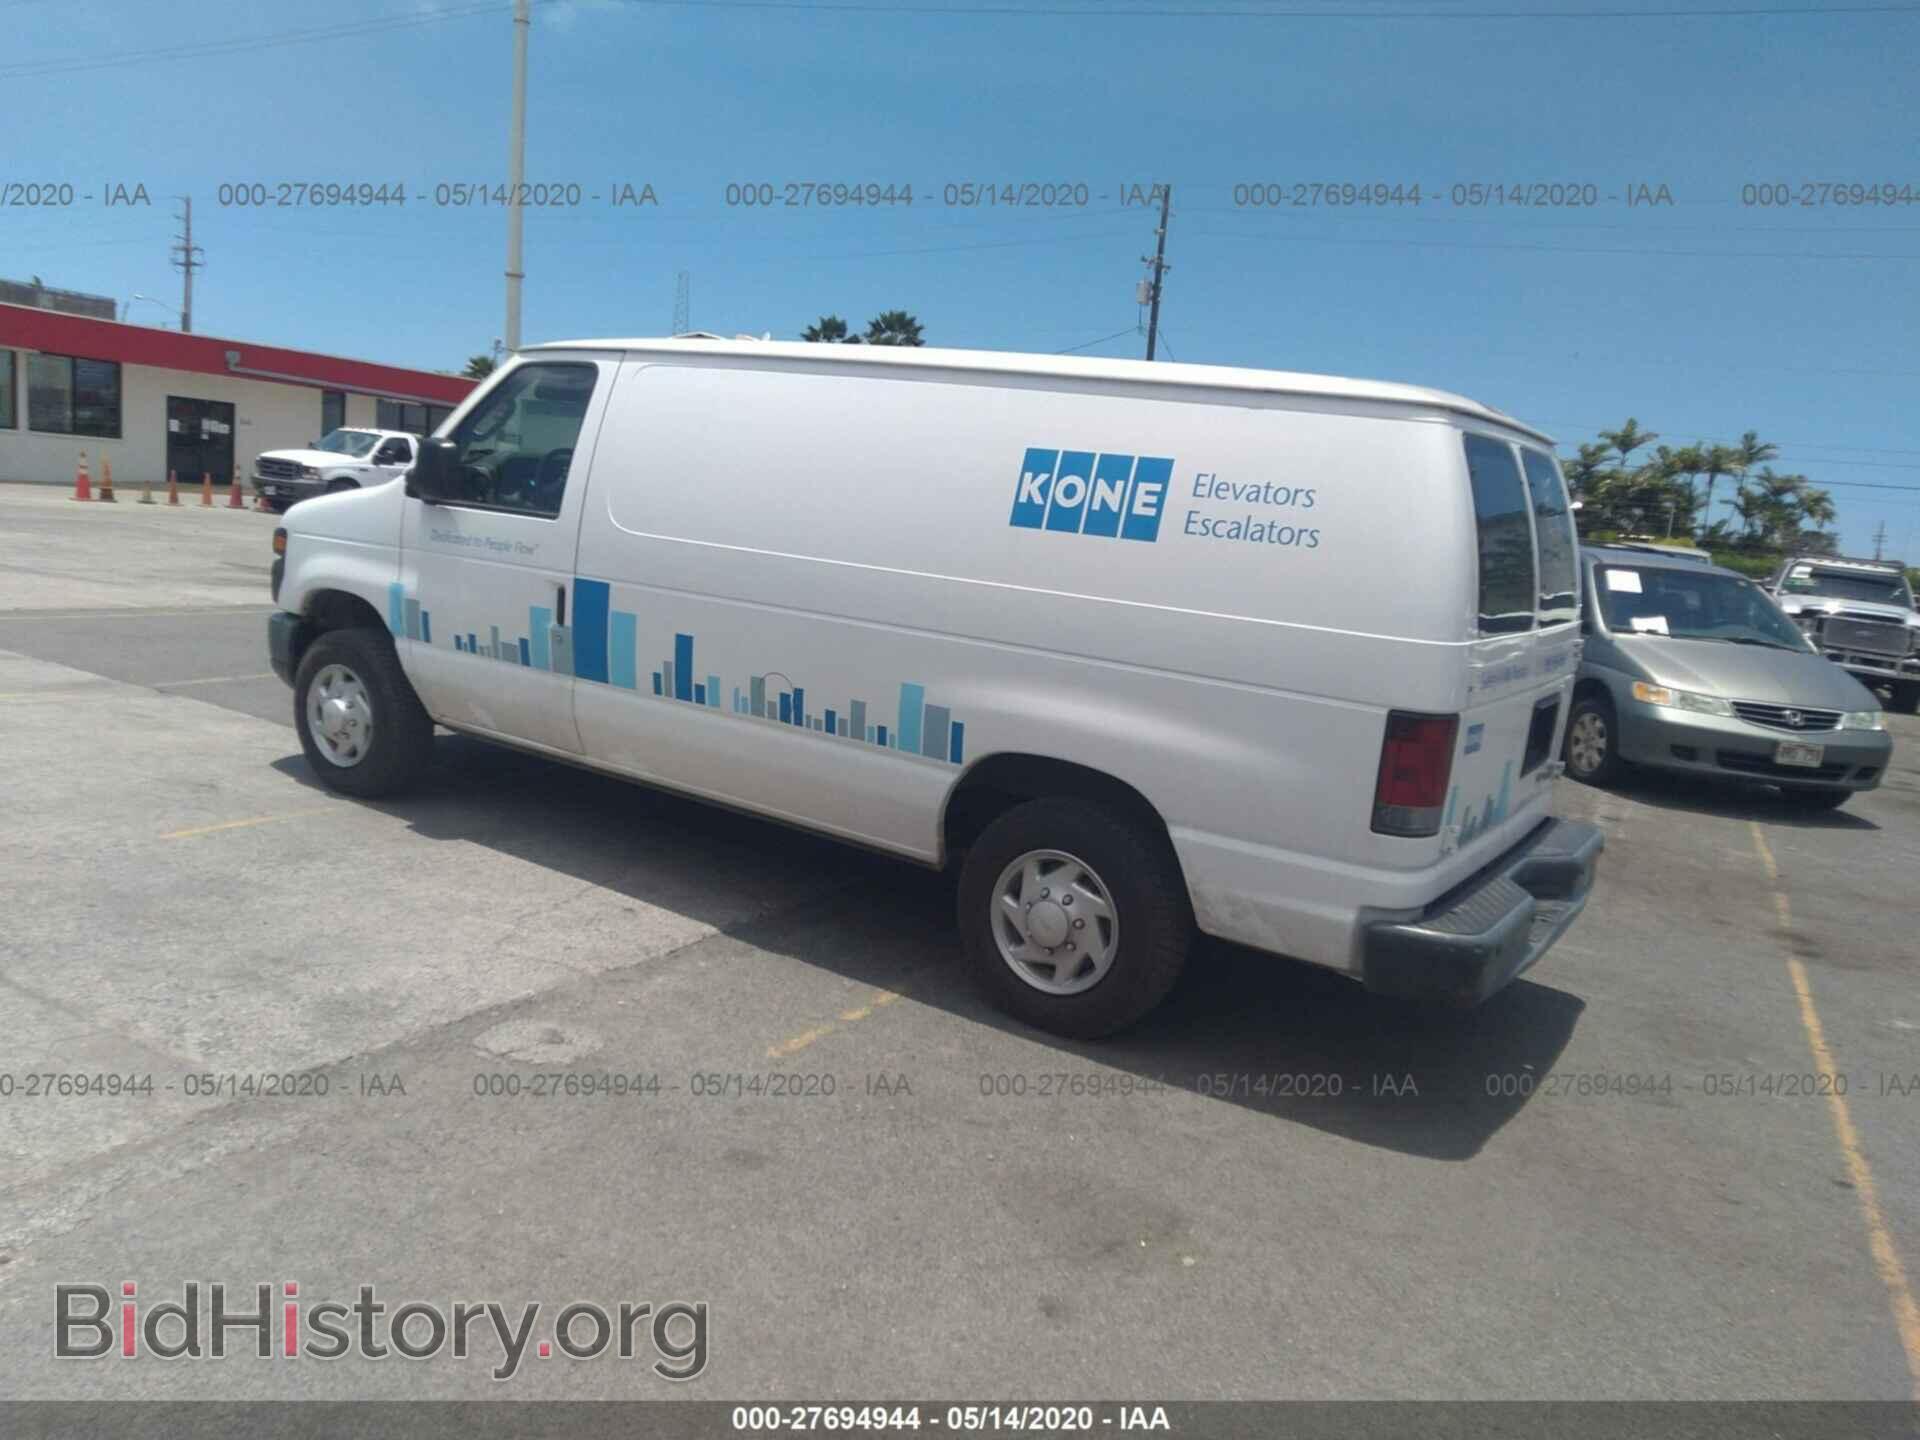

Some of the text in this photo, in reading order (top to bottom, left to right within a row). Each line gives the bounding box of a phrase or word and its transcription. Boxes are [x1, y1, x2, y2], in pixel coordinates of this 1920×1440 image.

[1018, 471, 1163, 517] KONE
[1192, 473, 1317, 508] Elevators
[1184, 510, 1321, 549] Escalators
